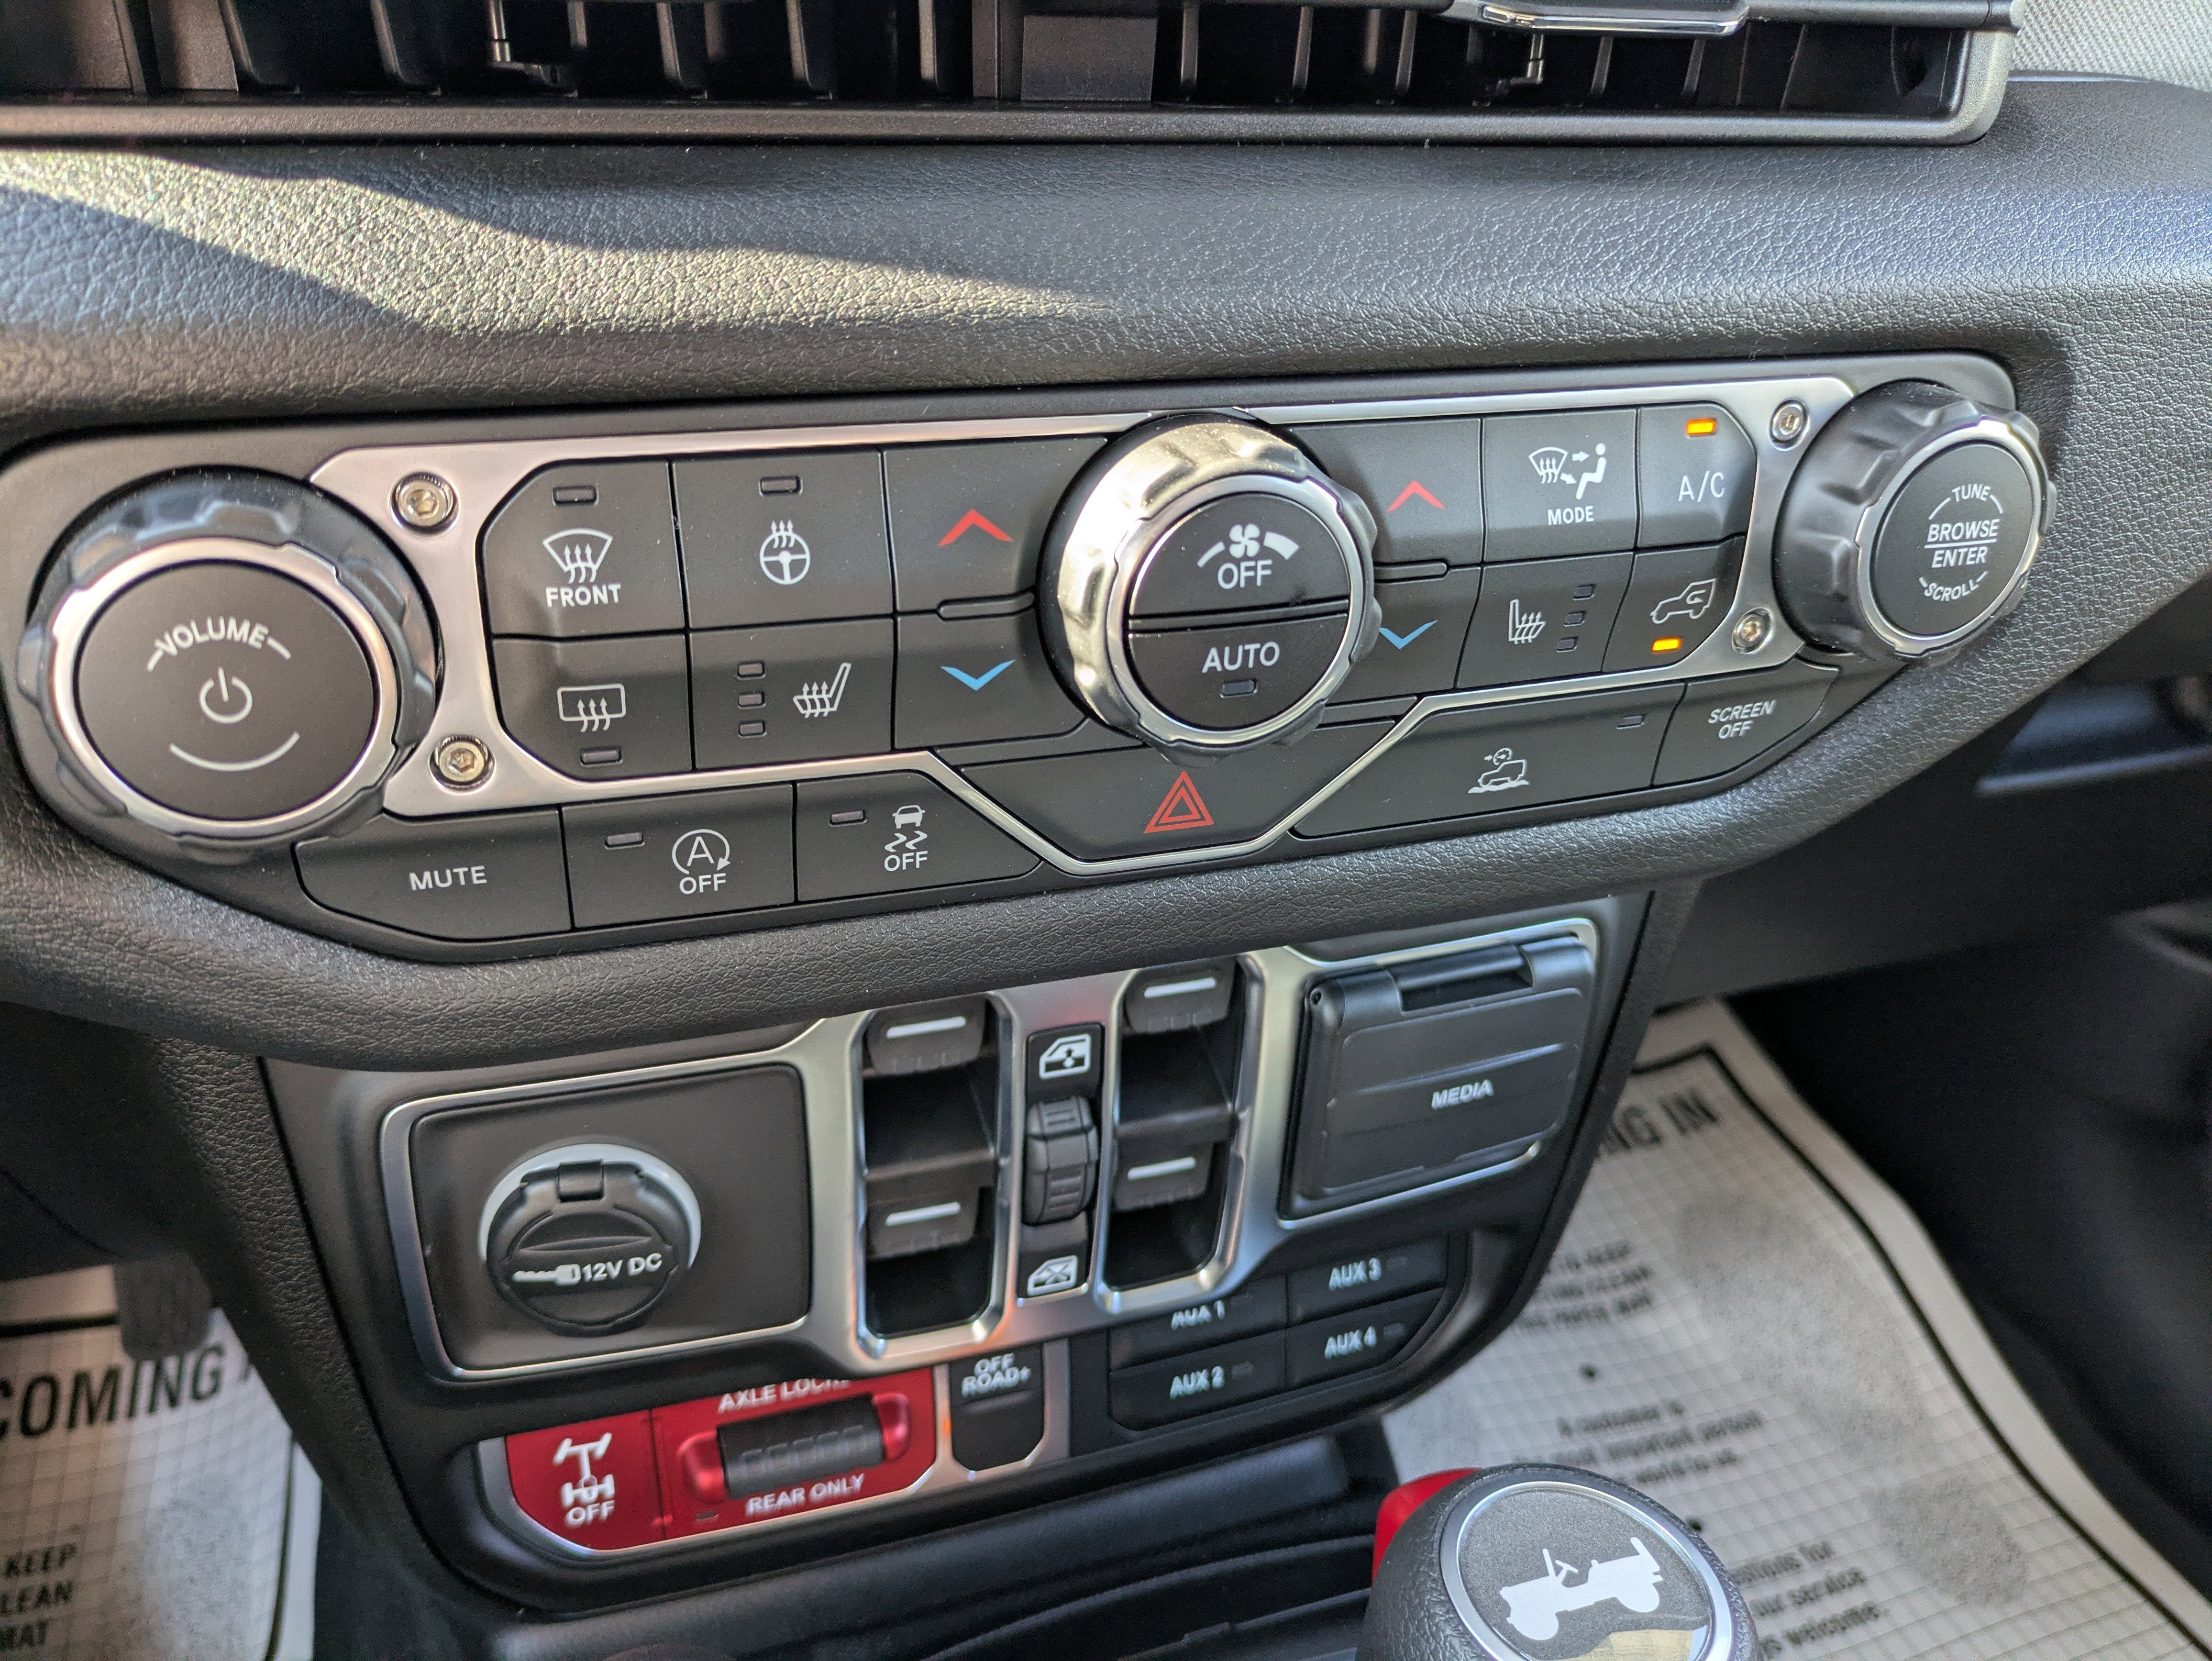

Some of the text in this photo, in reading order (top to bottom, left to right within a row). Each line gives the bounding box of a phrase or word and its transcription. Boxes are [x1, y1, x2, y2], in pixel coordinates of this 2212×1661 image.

[1679, 471, 1724, 502] A/C
[1952, 484, 1990, 502] TUNE
[1548, 506, 1593, 525] MODE
[1928, 518, 2000, 543] BROWSE
[1931, 546, 1988, 568] ENTER
[1218, 559, 1272, 589] OFF
[546, 584, 620, 607] FRONT
[1924, 577, 1979, 601] SCROLL
[159, 617, 269, 655] VOLUME
[1202, 641, 1279, 673] AUTO
[1708, 700, 1775, 721] SCREEN
[1718, 720, 1752, 739] OFF
[884, 851, 928, 871] OFF
[409, 866, 487, 890] MUTE
[678, 873, 726, 894] OFF
[1431, 1080, 1493, 1108] MEDIA
[583, 1252, 663, 1282] 12V DC
[1328, 1258, 1381, 1291] AUX 3
[1215, 1300, 1225, 1319] 1
[1324, 1326, 1377, 1359] AUX 4
[974, 1353, 1015, 1378] OFF
[1171, 1366, 1225, 1400] AUX 2
[719, 1383, 776, 1413] AXLE
[746, 1473, 864, 1517] REAR ONLY
[564, 1501, 614, 1526] OFF
[5, 1542, 77, 1577] KEEP
[0, 1581, 74, 1615] LEAN
